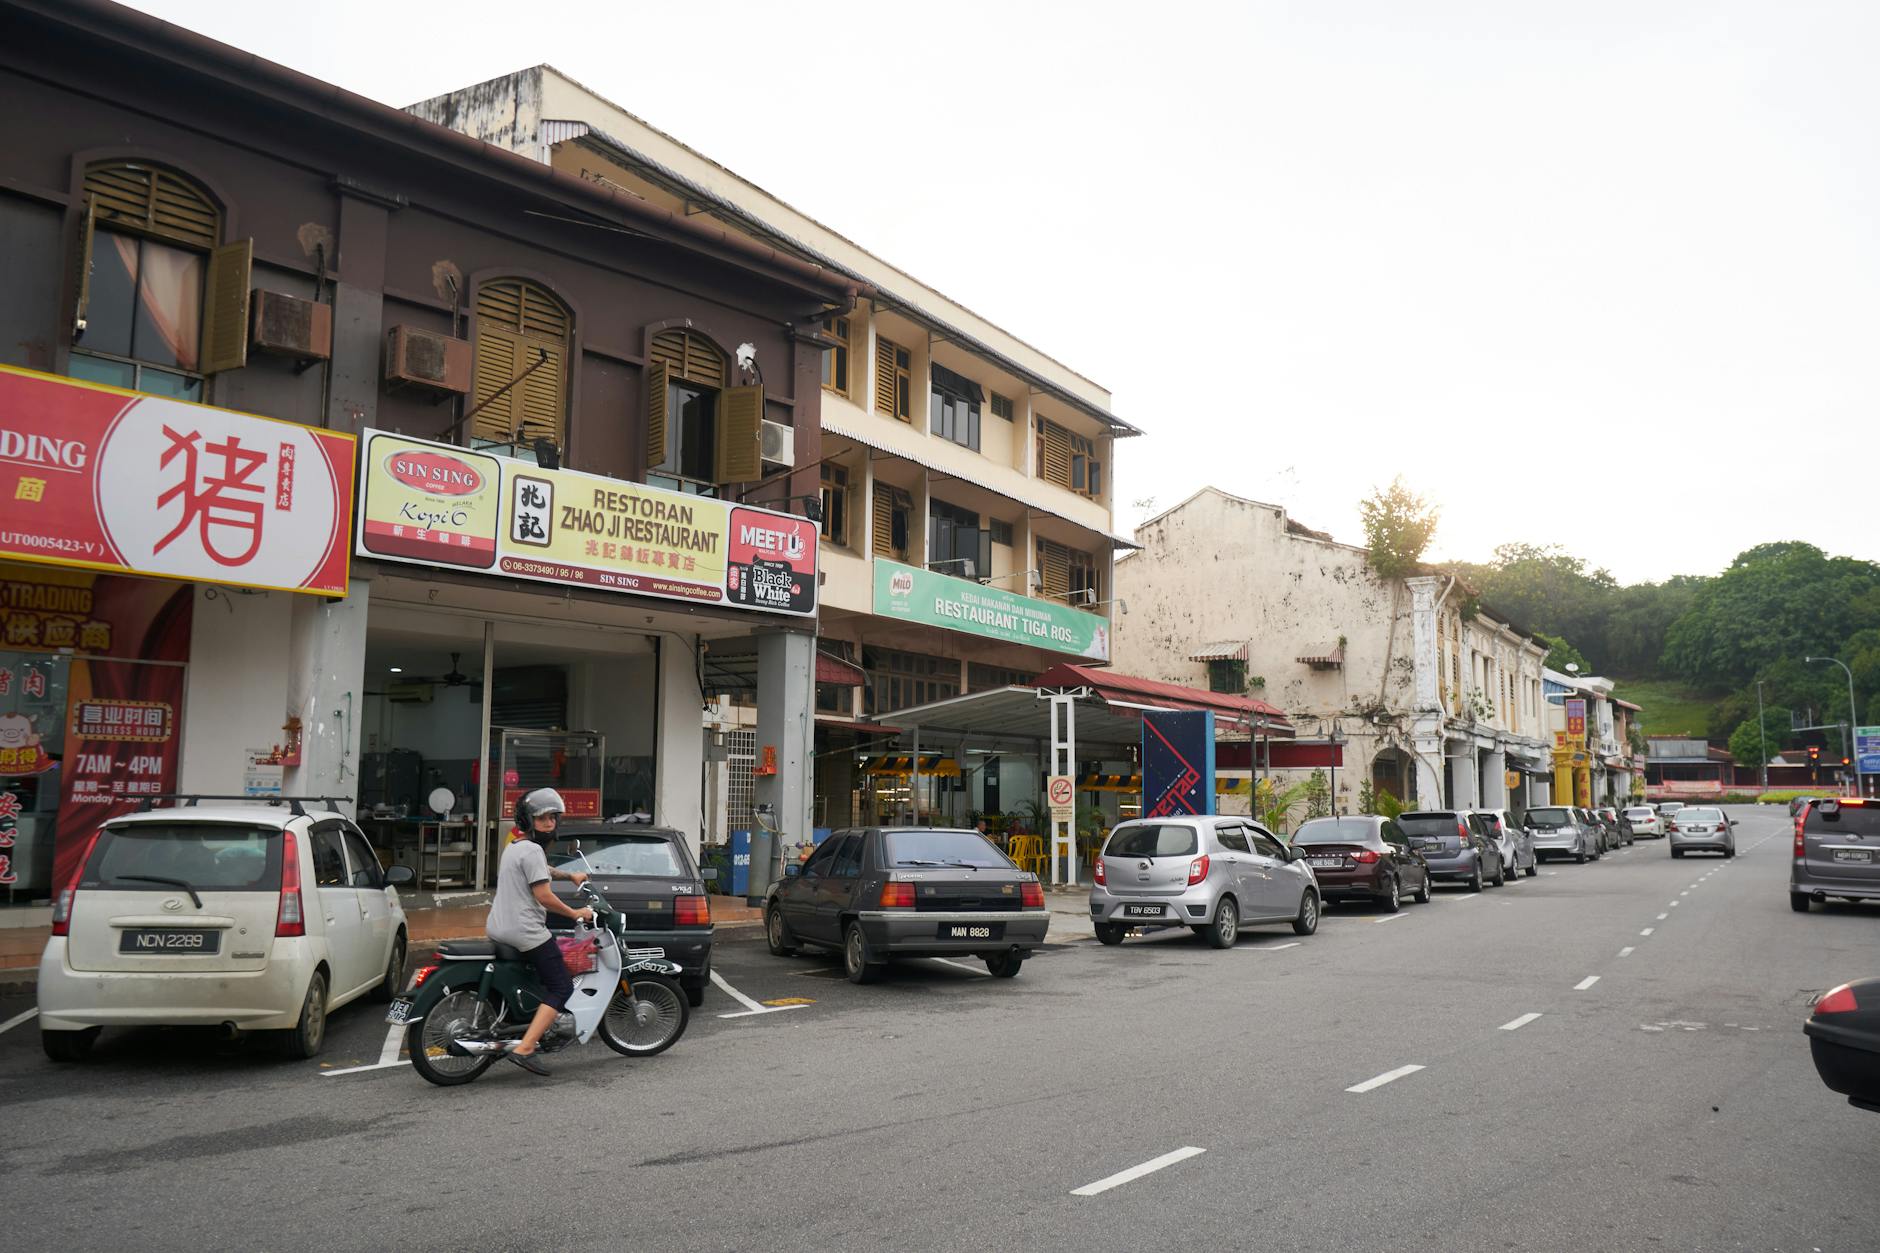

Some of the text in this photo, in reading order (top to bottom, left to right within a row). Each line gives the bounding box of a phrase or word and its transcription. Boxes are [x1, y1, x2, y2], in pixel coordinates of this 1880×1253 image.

[396, 460, 475, 488] SIN SING
[14, 476, 47, 502] 商
[153, 423, 268, 567] 猪
[425, 482, 445, 491] COFFEE
[399, 502, 449, 531] Kopi
[518, 484, 547, 540] 兆記
[593, 488, 694, 526] RESTORAN
[561, 505, 720, 554] ZHAO JI RESTAURANT
[740, 524, 787, 552] MEET
[512, 561, 555, 576] 06-3373490
[560, 568, 570, 578] 95
[574, 570, 585, 580] 96
[599, 573, 640, 588] SIN SING
[752, 566, 793, 589] Black
[652, 580, 722, 600] www.sinsingcoffee.com
[753, 583, 791, 603] White
[892, 577, 911, 590] MILO
[7, 583, 93, 614] TRADING
[935, 597, 1018, 632] RESTAURANT
[1021, 618, 1048, 638] TIGA
[1051, 625, 1073, 643] ROS
[6, 613, 111, 651] 供应商
[83, 705, 162, 726] 营业时间
[82, 724, 161, 736] BUSINESS HOUR
[77, 754, 111, 773] 7AM
[128, 756, 162, 774] 4PM
[73, 780, 110, 792] 星期一
[72, 793, 113, 804] Monday
[136, 934, 204, 948] NCN 2289
[951, 926, 990, 937] MAN 8828
